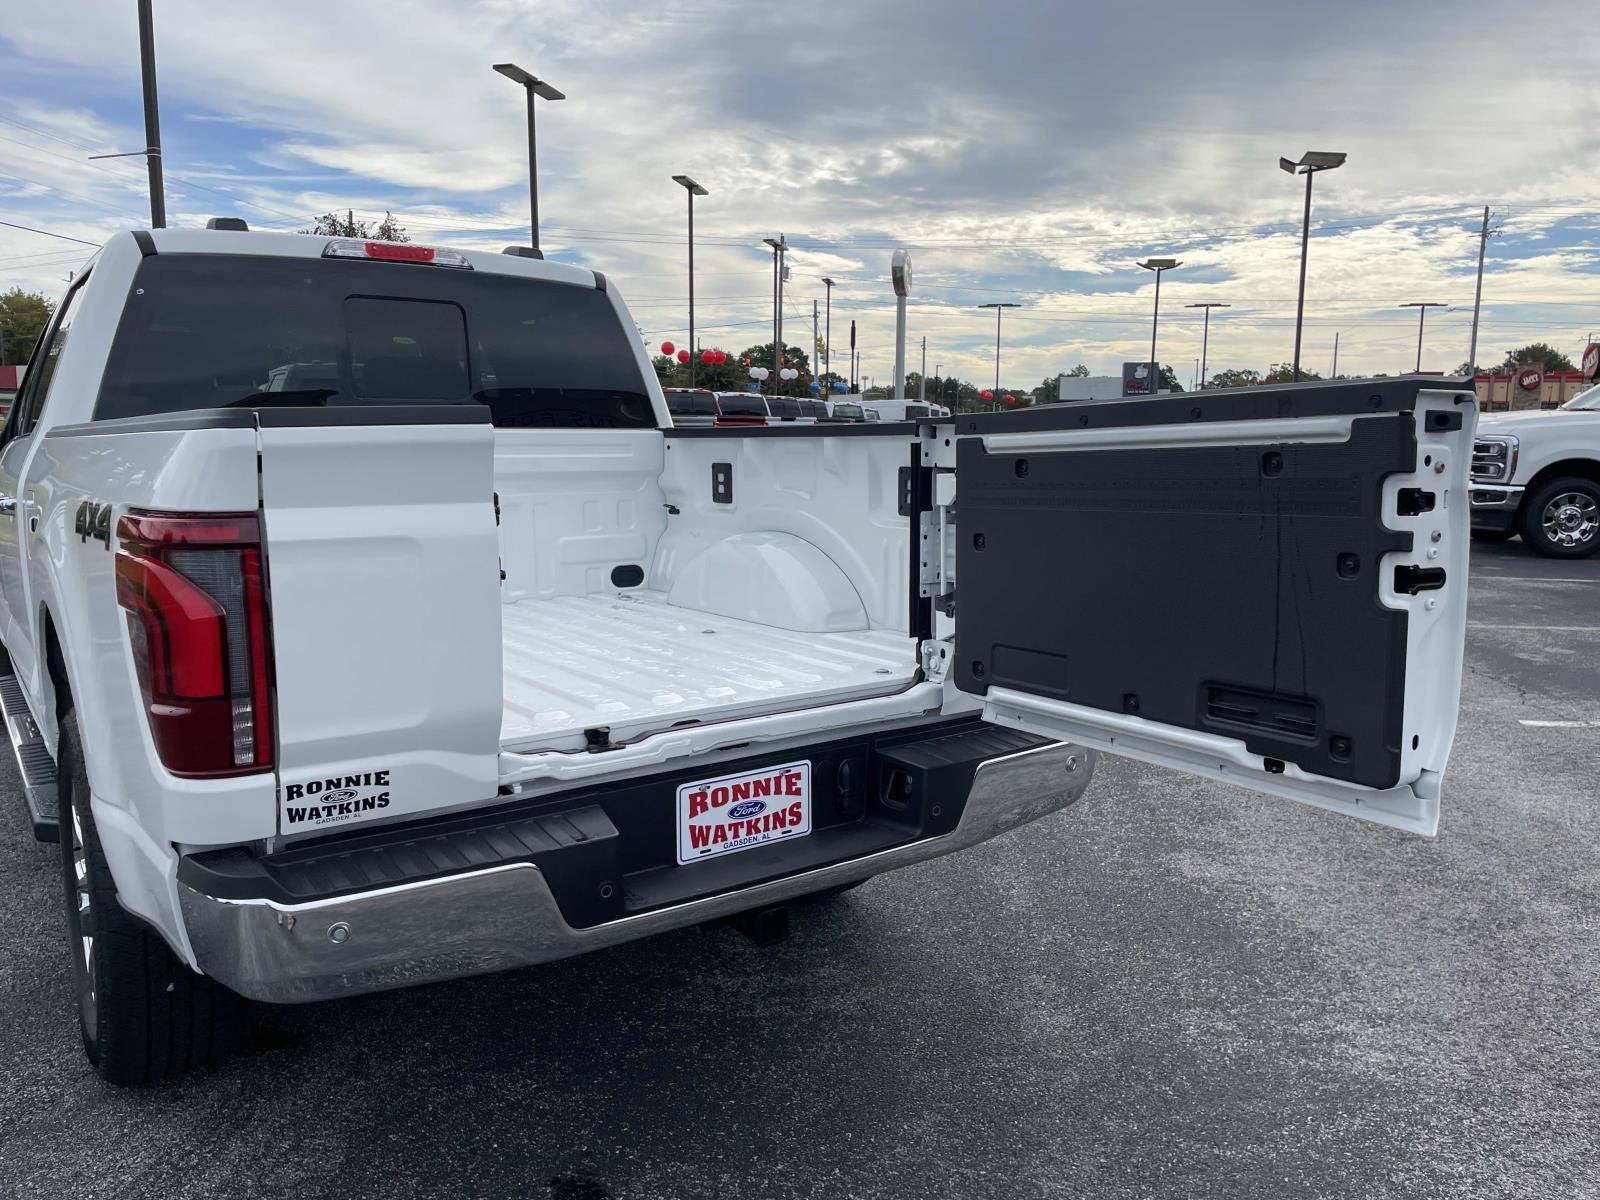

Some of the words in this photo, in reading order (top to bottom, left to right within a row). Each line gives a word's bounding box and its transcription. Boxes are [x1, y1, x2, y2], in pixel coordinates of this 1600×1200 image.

[286, 770, 390, 802] RONNIE
[688, 772, 802, 819] RONNIE
[286, 792, 390, 823] WATKINS
[733, 802, 761, 817] Ford
[688, 801, 803, 849] WATKINS
